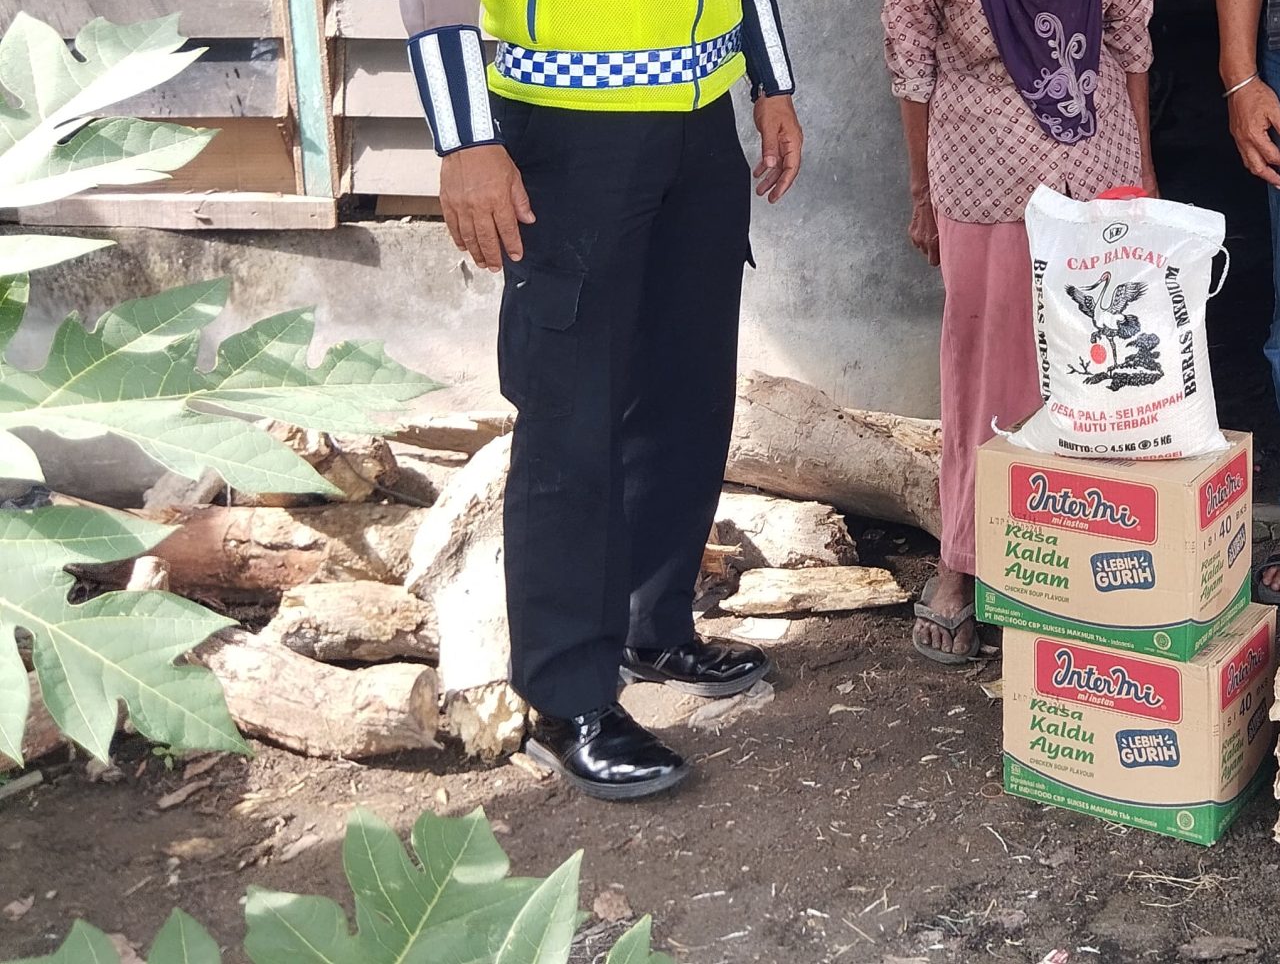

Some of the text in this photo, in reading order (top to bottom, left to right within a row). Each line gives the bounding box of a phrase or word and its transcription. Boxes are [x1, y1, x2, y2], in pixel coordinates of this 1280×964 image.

[1066, 245, 1168, 271] CAP BANGAU
[1165, 265, 1197, 399] BERAS MEDIUM
[1050, 402, 1075, 419] DESA
[1077, 410, 1107, 422] PALA
[1115, 407, 1134, 420] SEI
[1137, 391, 1183, 416] RAMPAH
[1073, 413, 1159, 433] MUTU TERBAIK
[1058, 434, 1172, 453] BRUTTO: 4.5 KG 5 KG
[1005, 523, 1058, 546] Rasa
[1051, 516, 1062, 526] mi
[1062, 518, 1090, 531] instan
[1219, 514, 1232, 538] 40
[1004, 540, 1070, 570] Kaldu
[1104, 556, 1139, 572] LEBIH
[1004, 561, 1070, 590] Ayam
[1095, 569, 1152, 588] GURIH
[1004, 585, 1070, 603] CHICKEN SOUP FLAVOUR
[1029, 697, 1083, 721] Rasa
[1077, 693, 1115, 707] mi instan
[1239, 692, 1252, 716] 40
[1030, 714, 1095, 744] Kaldu
[1029, 735, 1095, 765] Ayam
[1129, 734, 1163, 749] LEBIH
[1121, 745, 1177, 764] GURIH
[1029, 758, 1095, 778] CHICKEN SOUP FLAVOUR
